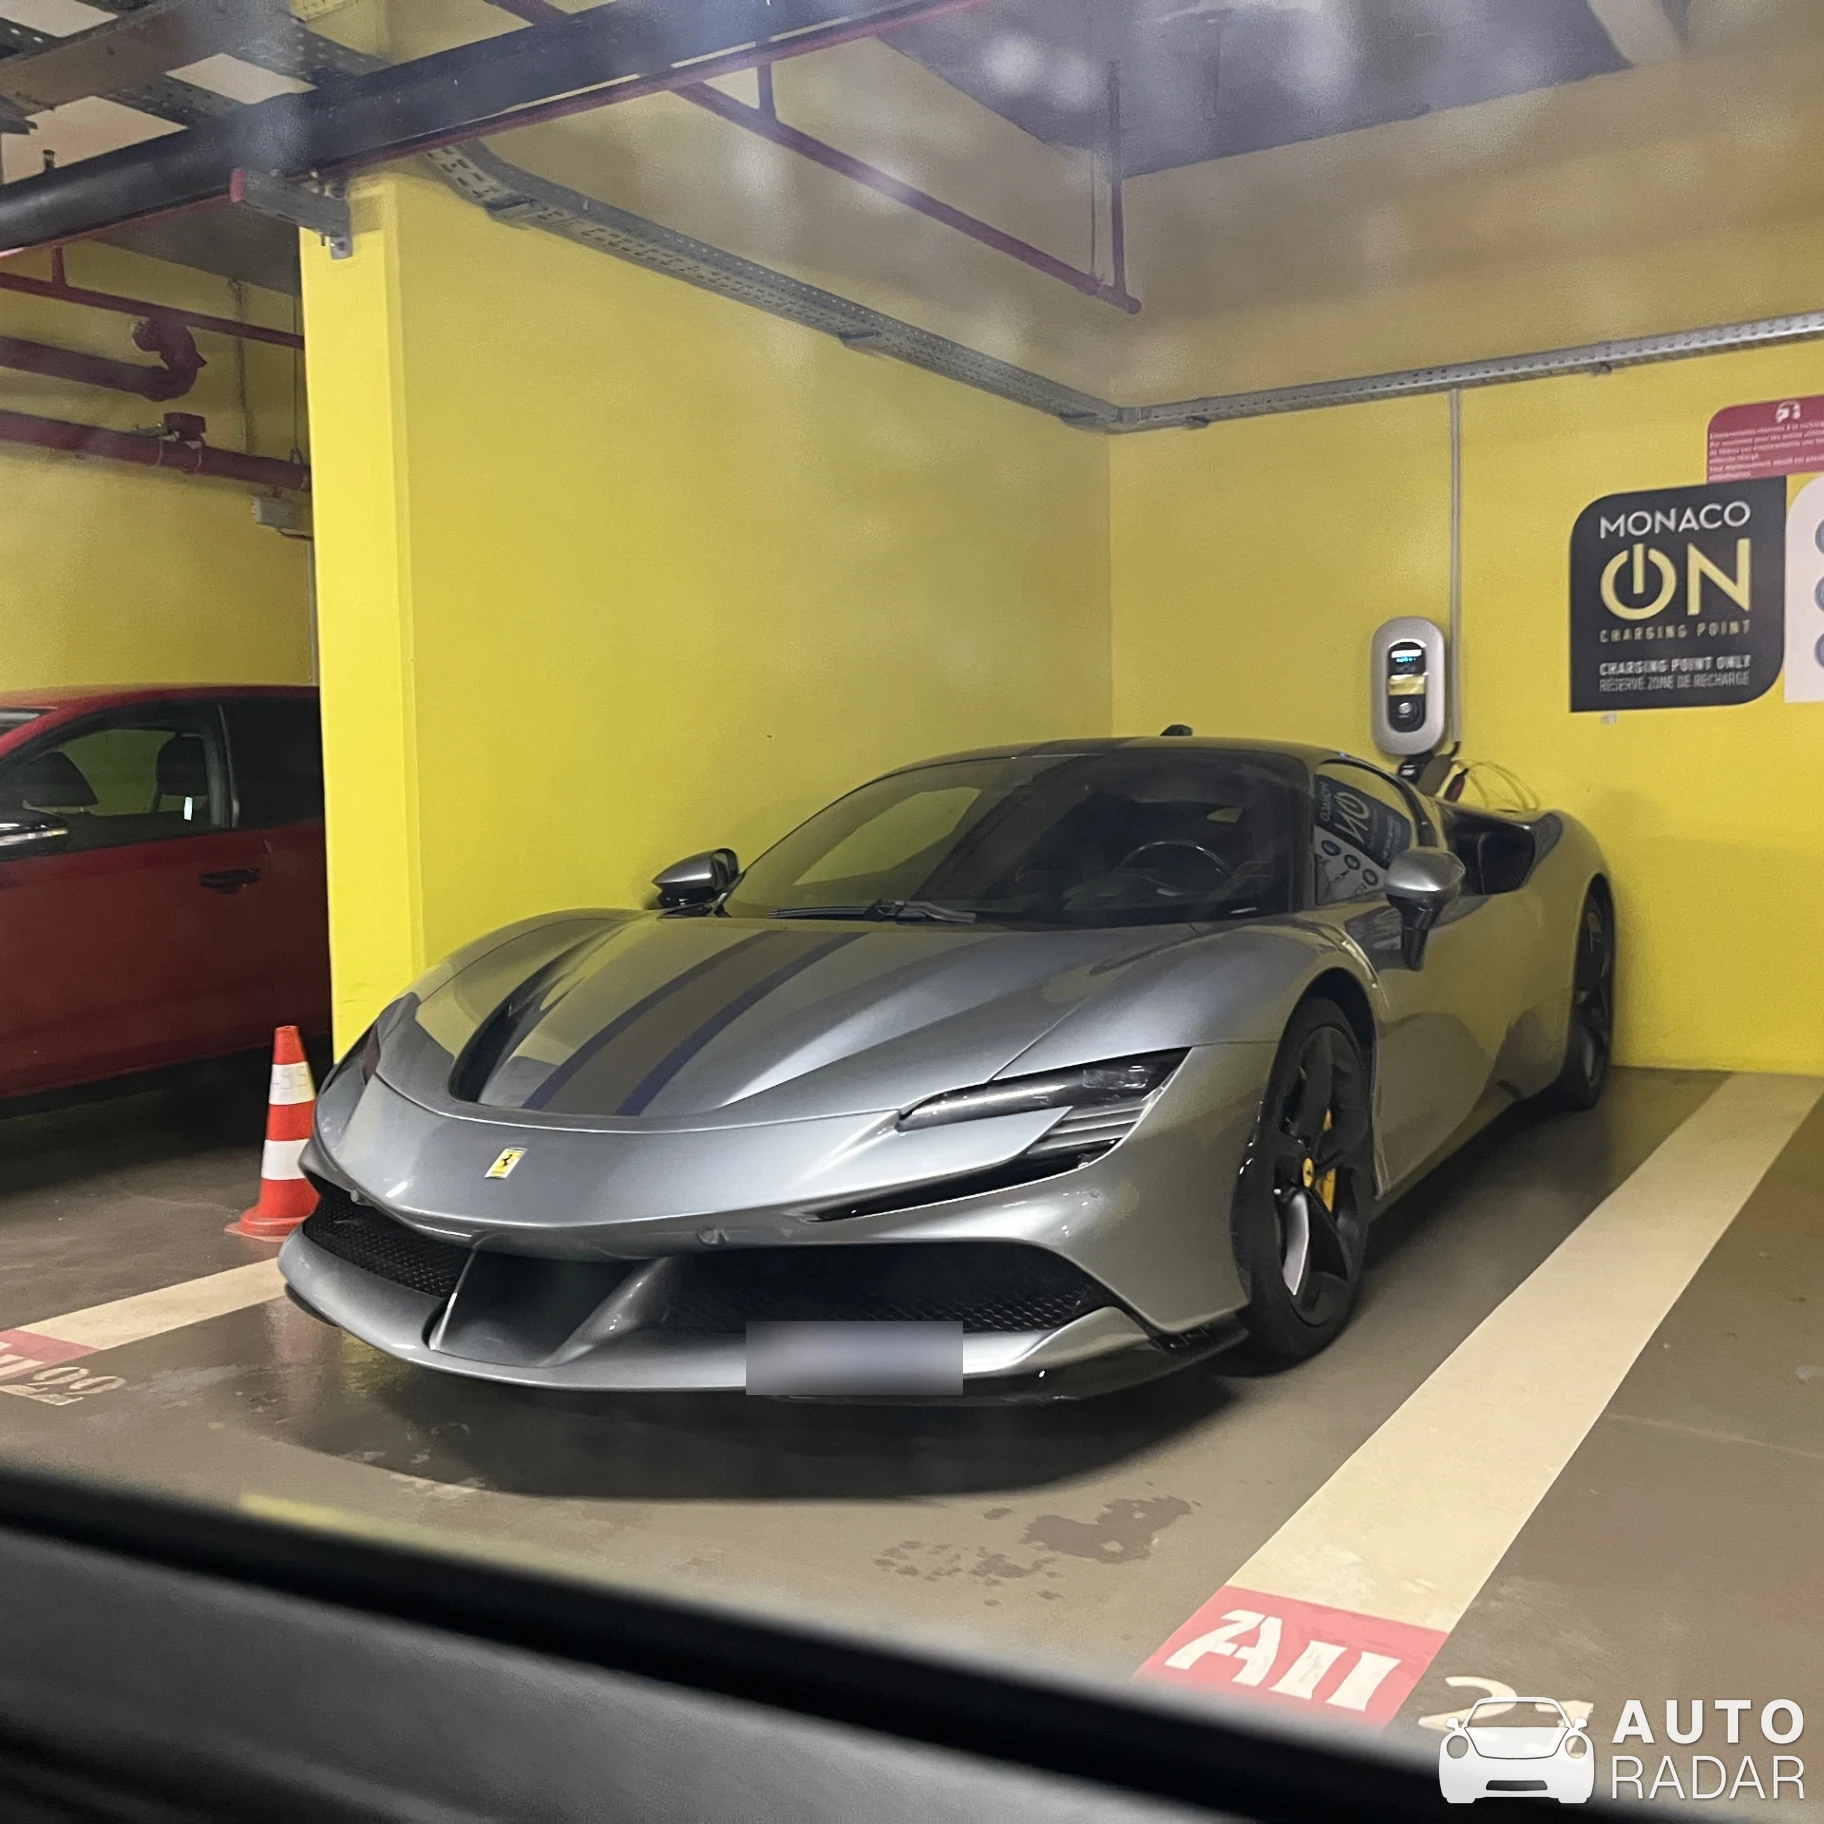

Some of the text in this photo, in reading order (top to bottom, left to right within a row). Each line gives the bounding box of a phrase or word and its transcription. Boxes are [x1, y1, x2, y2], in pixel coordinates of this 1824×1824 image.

[1600, 501, 1751, 539] MONACO
[1600, 537, 1751, 621] ON
[1600, 619, 1750, 643] CHARGING POINT
[1599, 655, 1751, 676] CHARGING POINT ONLY
[1647, 674, 1675, 690] ZONE
[1677, 673, 1692, 689] DE
[1694, 670, 1750, 688] RECHARGE
